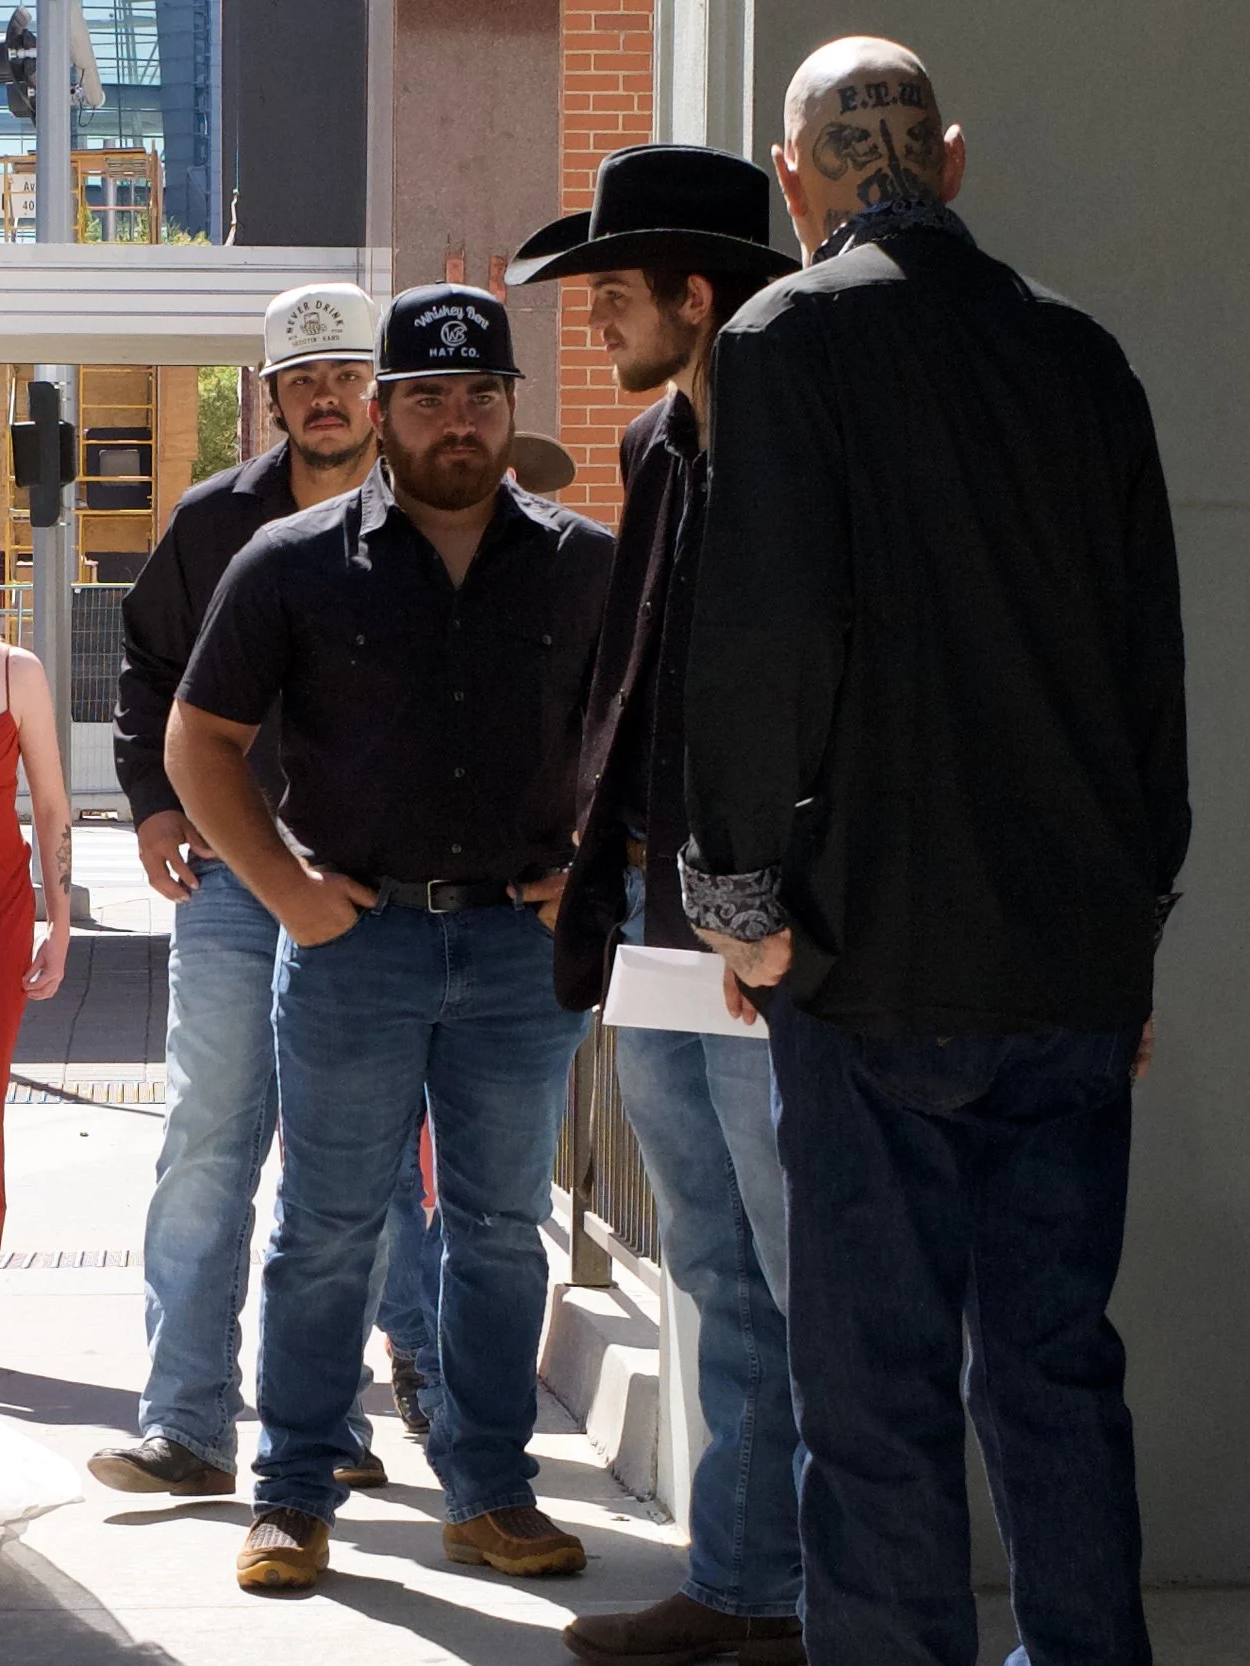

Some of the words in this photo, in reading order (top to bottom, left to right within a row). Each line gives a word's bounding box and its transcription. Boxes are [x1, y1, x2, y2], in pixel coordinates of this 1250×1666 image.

[286, 302, 310, 334] NEVER
[315, 300, 345, 327] DRINK
[414, 305, 464, 328] Whiskey
[429, 347, 455, 358] HAT
[461, 347, 480, 358] CO.
